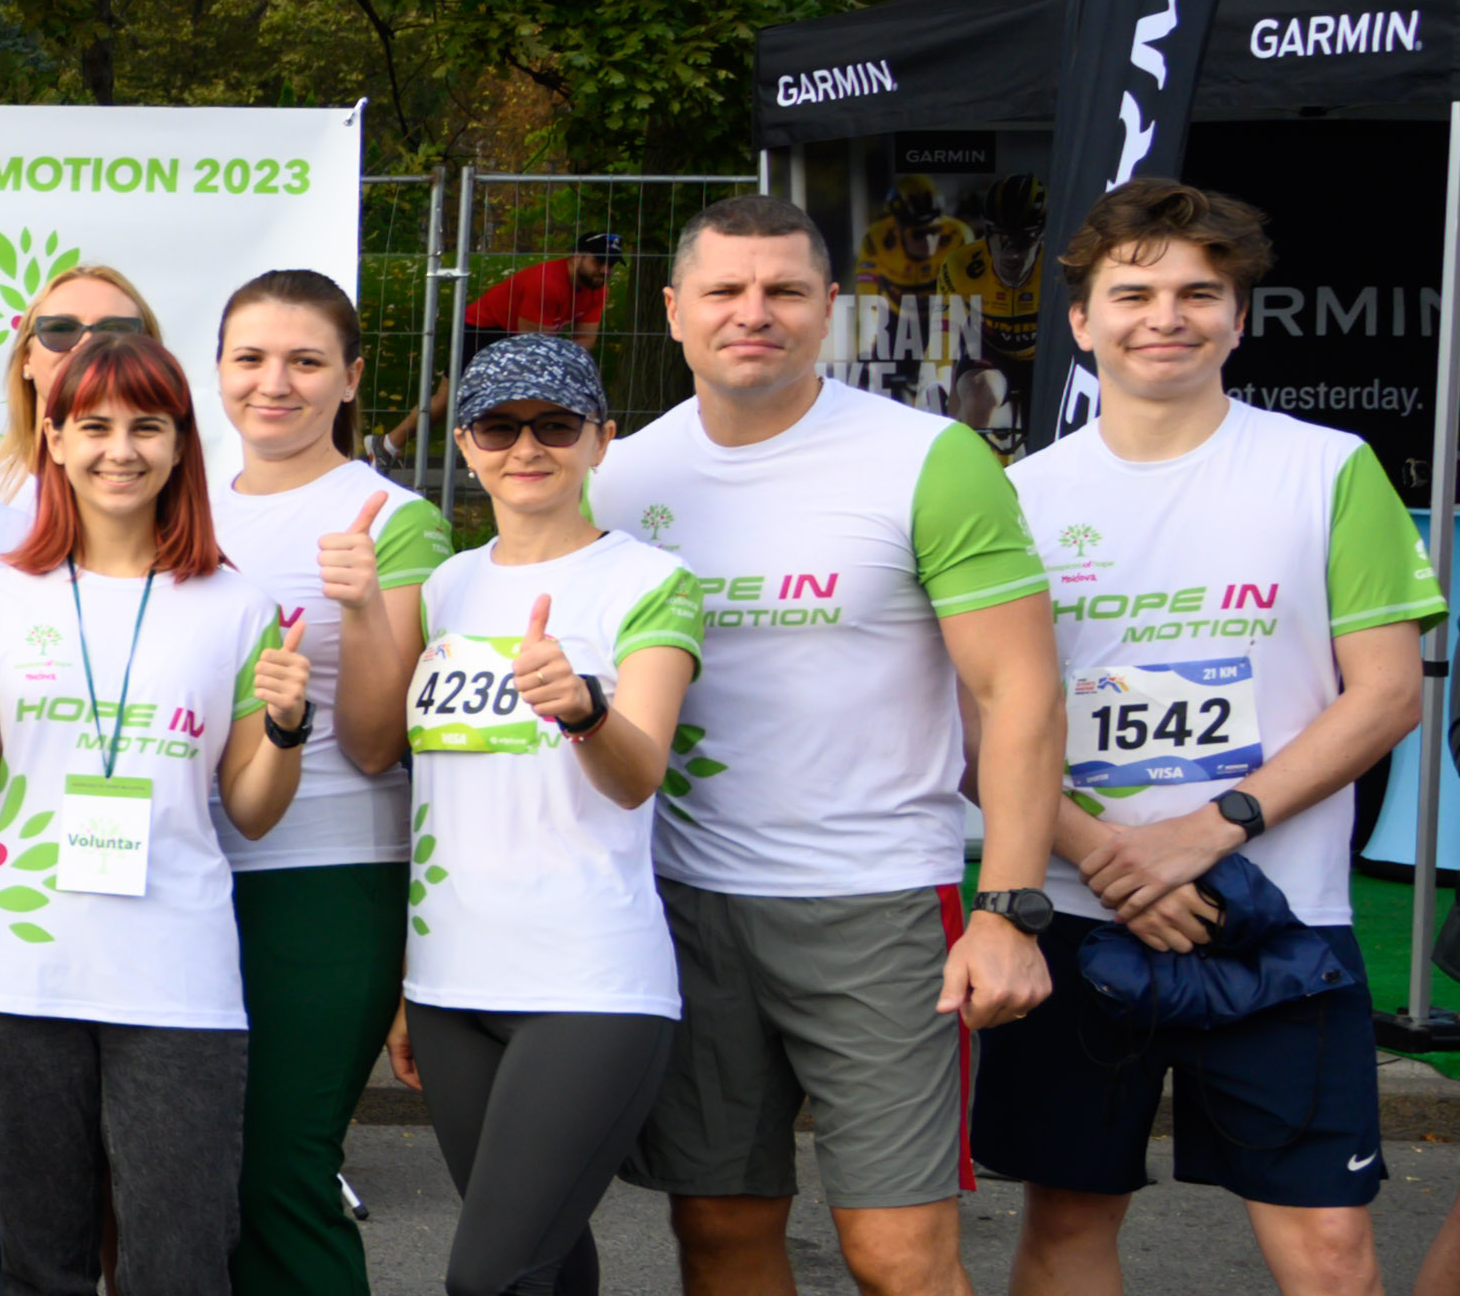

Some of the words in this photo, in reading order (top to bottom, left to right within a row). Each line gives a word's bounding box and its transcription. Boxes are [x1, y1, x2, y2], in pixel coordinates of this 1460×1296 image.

[1250, 10, 1420, 60] GARMIN
[777, 60, 895, 107] GARMIN
[906, 150, 985, 163] GARMIN
[194, 158, 311, 194] 2023
[826, 294, 982, 361] TRAIN
[1262, 379, 1423, 416] yesterday.
[778, 573, 838, 600] IN
[1053, 586, 1207, 625] HOPE
[1221, 583, 1279, 609] IN
[1121, 618, 1278, 645] MOTION
[1203, 668, 1216, 680] 21
[1219, 666, 1237, 679] KM
[414, 670, 521, 716] 4236
[15, 697, 158, 727] HOPE
[1092, 697, 1232, 751] 1542
[1145, 766, 1184, 780] VISA
[67, 832, 142, 851] Voluntar
